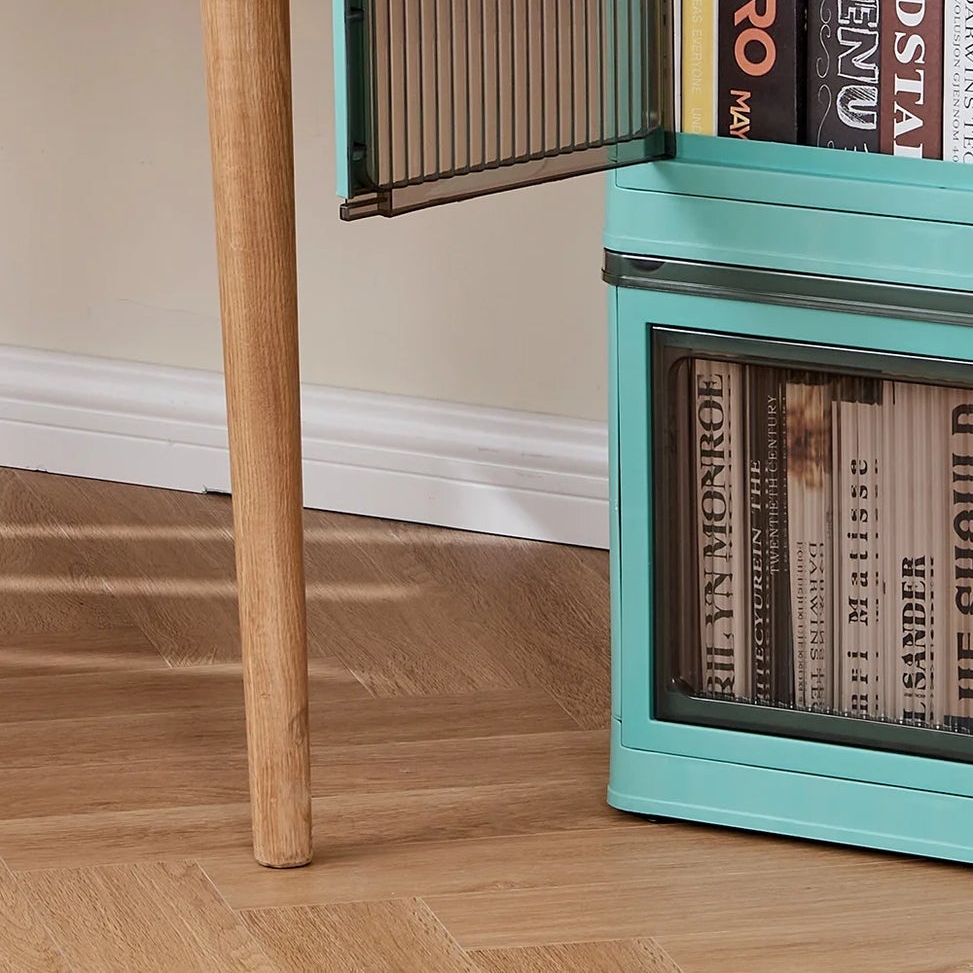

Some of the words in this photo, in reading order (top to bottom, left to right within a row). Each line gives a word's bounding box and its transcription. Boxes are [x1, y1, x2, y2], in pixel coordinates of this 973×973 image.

[730, 90, 751, 140] MAY
[952, 73, 961, 141] GJENNOM
[697, 372, 731, 562] MONROE
[766, 394, 779, 473] CENTURY
[749, 459, 763, 513] THE
[768, 477, 780, 575] TWENTIETH
